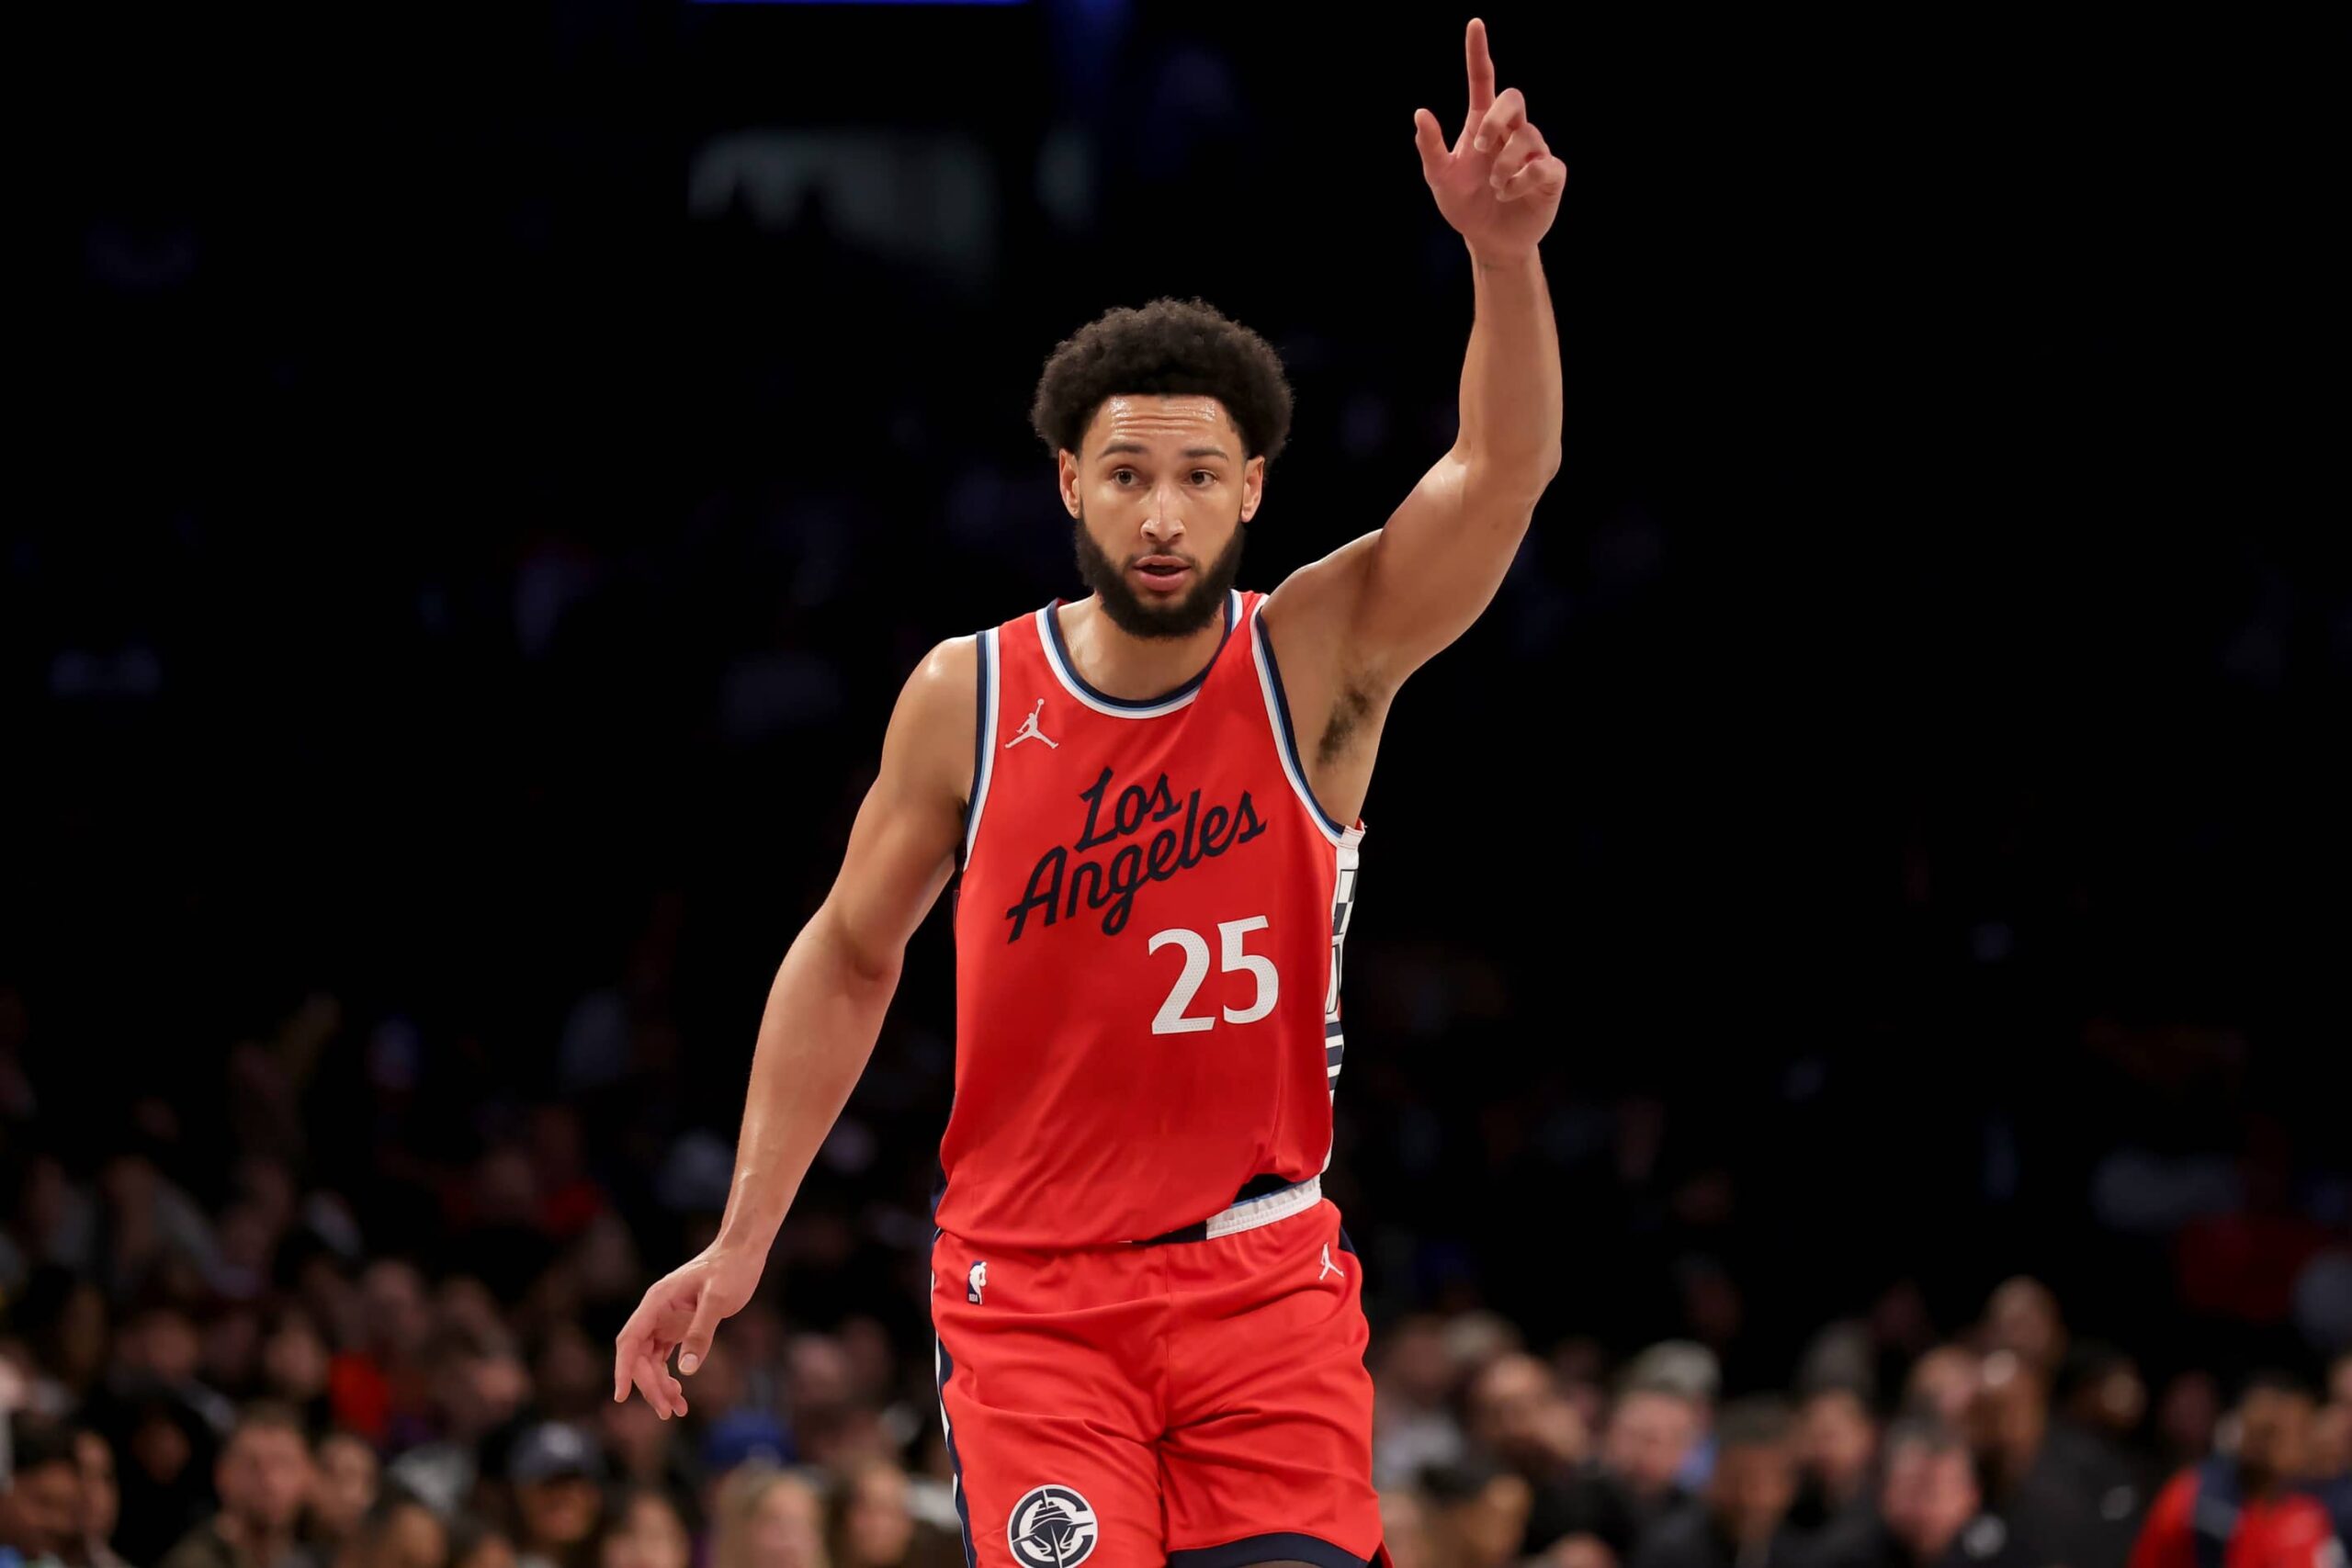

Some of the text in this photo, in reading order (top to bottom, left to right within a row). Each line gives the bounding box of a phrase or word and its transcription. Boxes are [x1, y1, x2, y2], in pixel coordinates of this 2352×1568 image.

[1005, 789, 1268, 944] Angeles
[1073, 766, 1182, 854] Los
[1148, 915, 1280, 1035] 25
